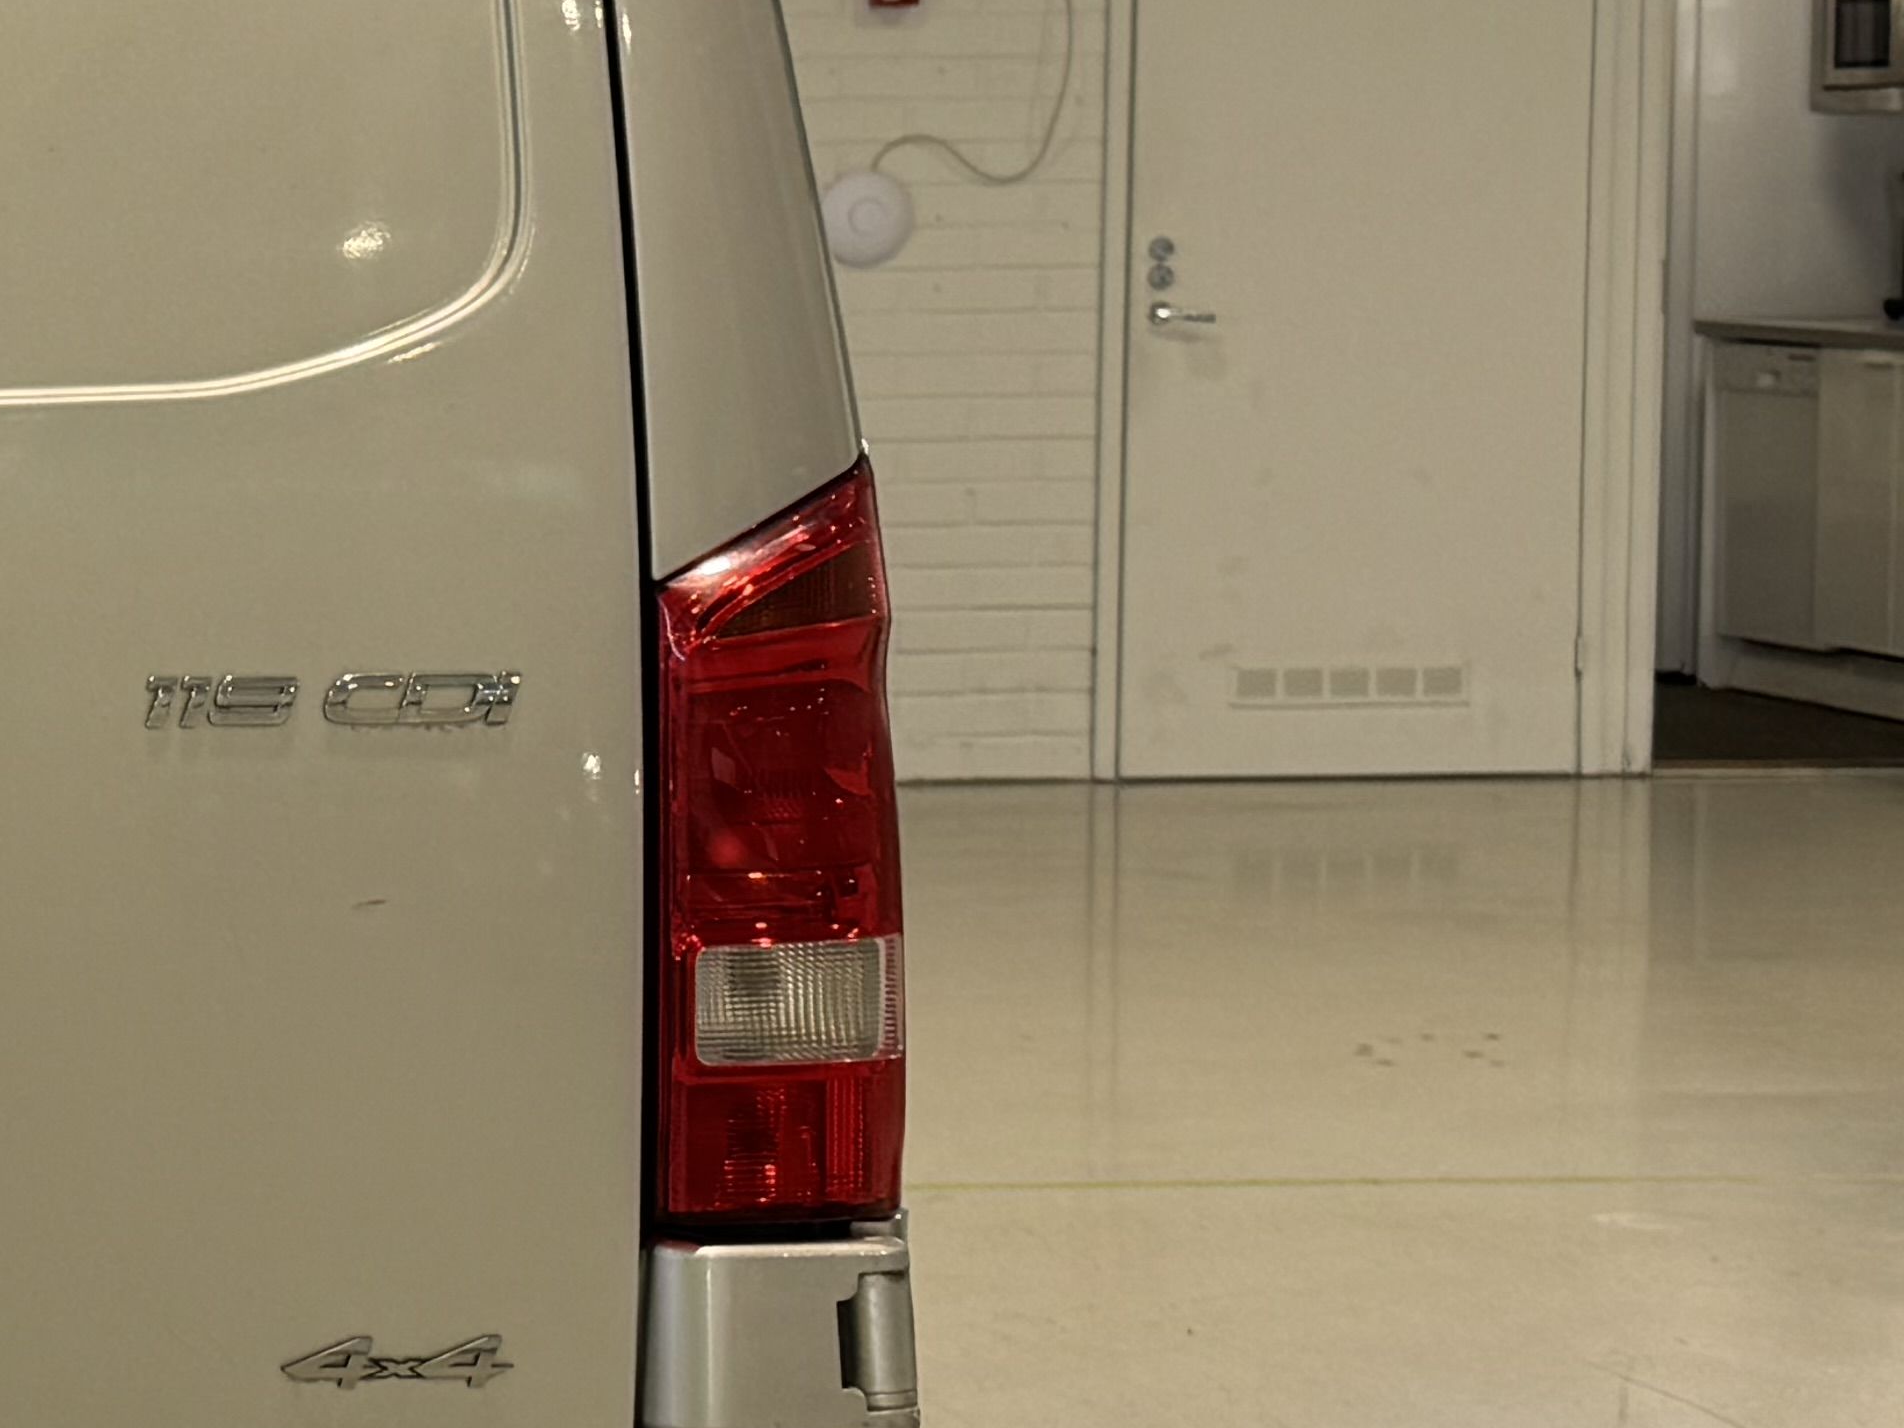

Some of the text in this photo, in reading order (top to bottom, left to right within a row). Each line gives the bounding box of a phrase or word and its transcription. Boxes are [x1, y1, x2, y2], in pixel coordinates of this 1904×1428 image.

[145, 671, 522, 729] 119 CDI
[280, 1333, 514, 1389] 4x4
